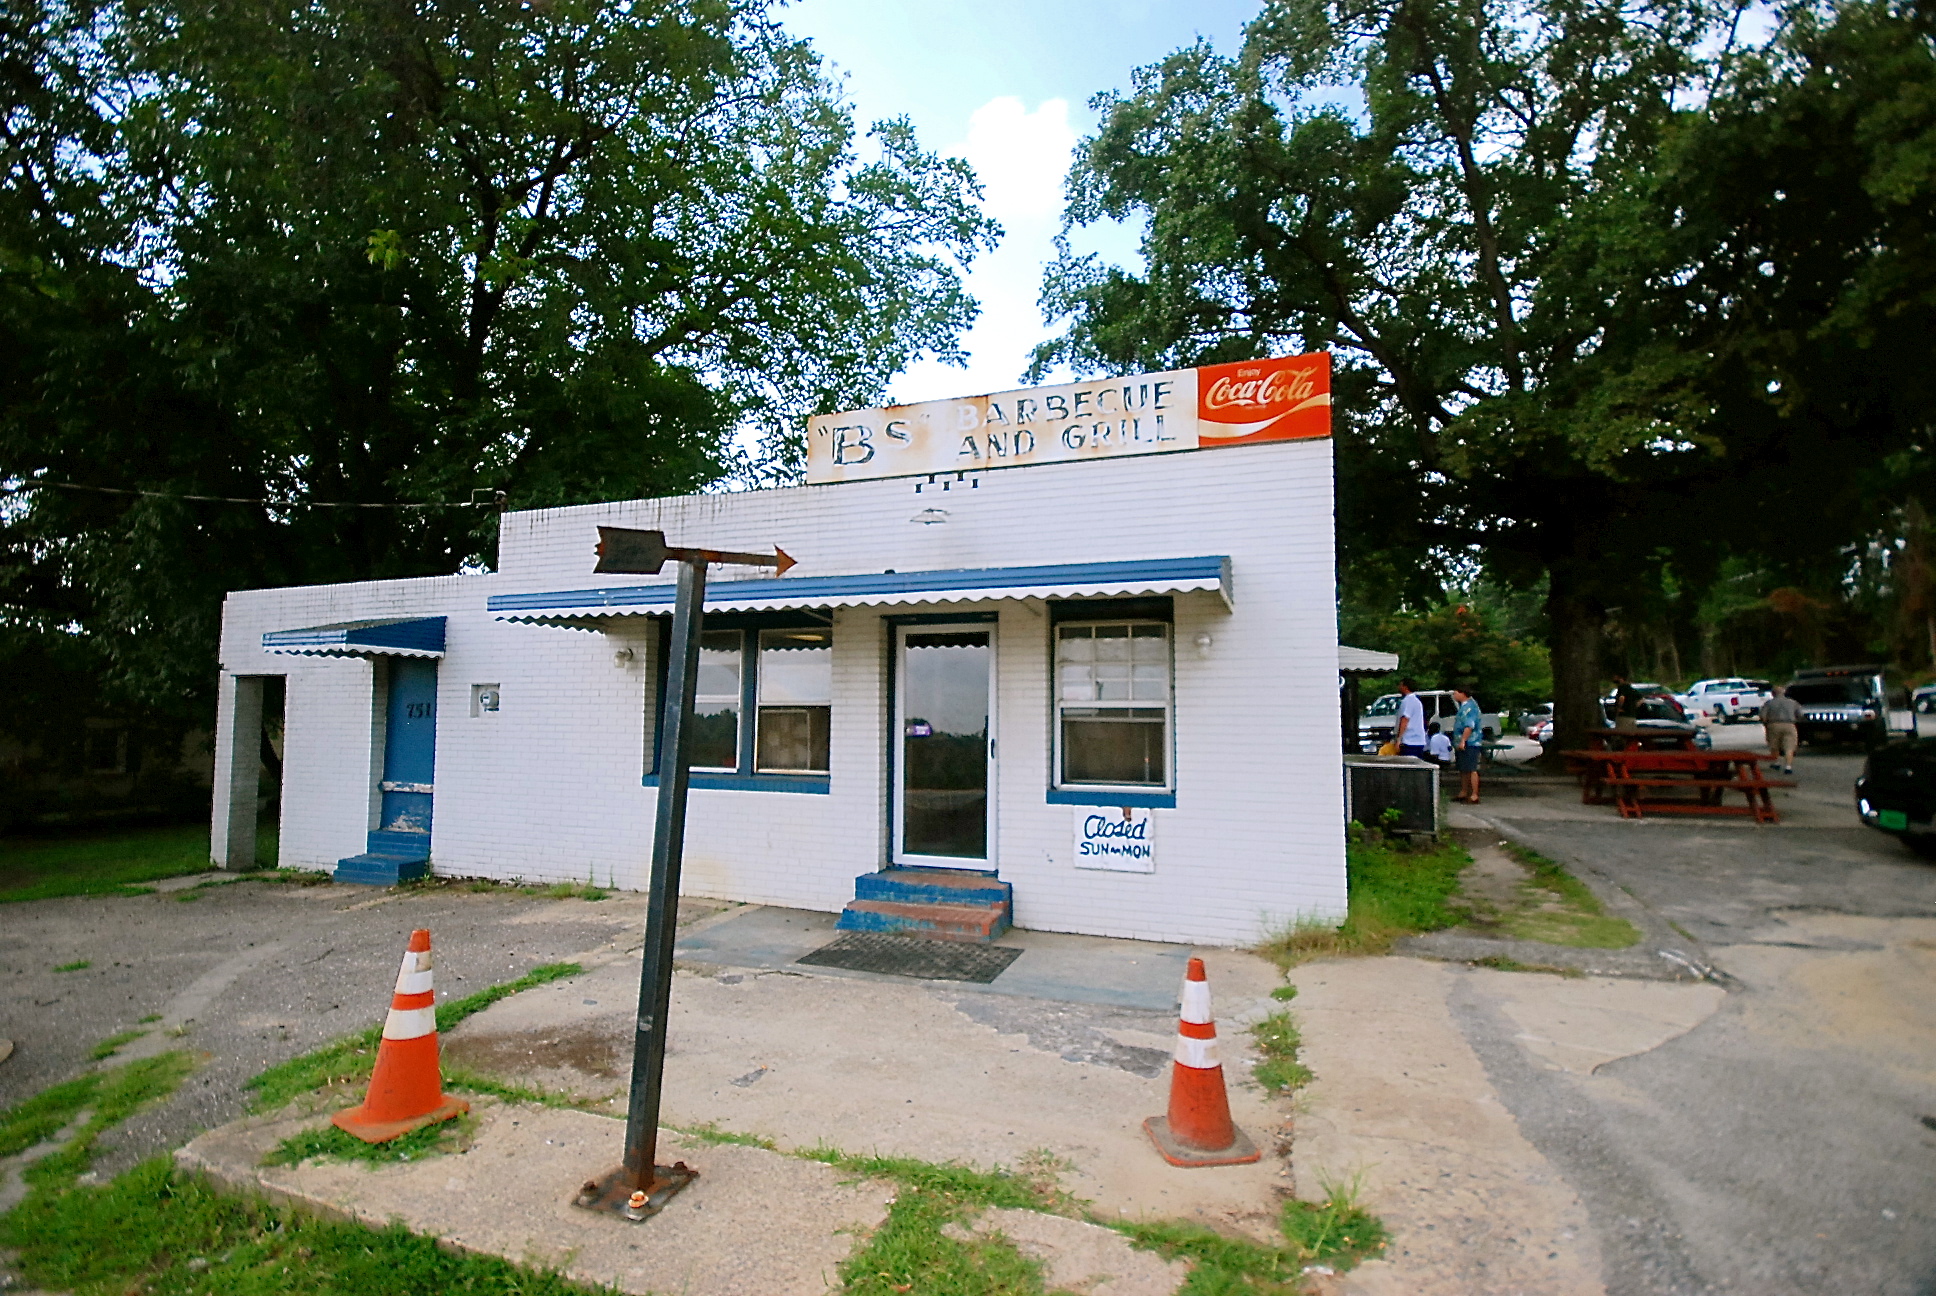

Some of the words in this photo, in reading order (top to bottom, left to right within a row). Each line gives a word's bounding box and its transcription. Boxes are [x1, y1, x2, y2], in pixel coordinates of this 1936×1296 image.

[956, 380, 1174, 432] BARBECUE
[1205, 366, 1319, 410] Coca-Cola
[956, 429, 1035, 461] AND
[1061, 414, 1176, 450] GRILL
[406, 702, 431, 718] 751
[1084, 814, 1147, 839] Closed
